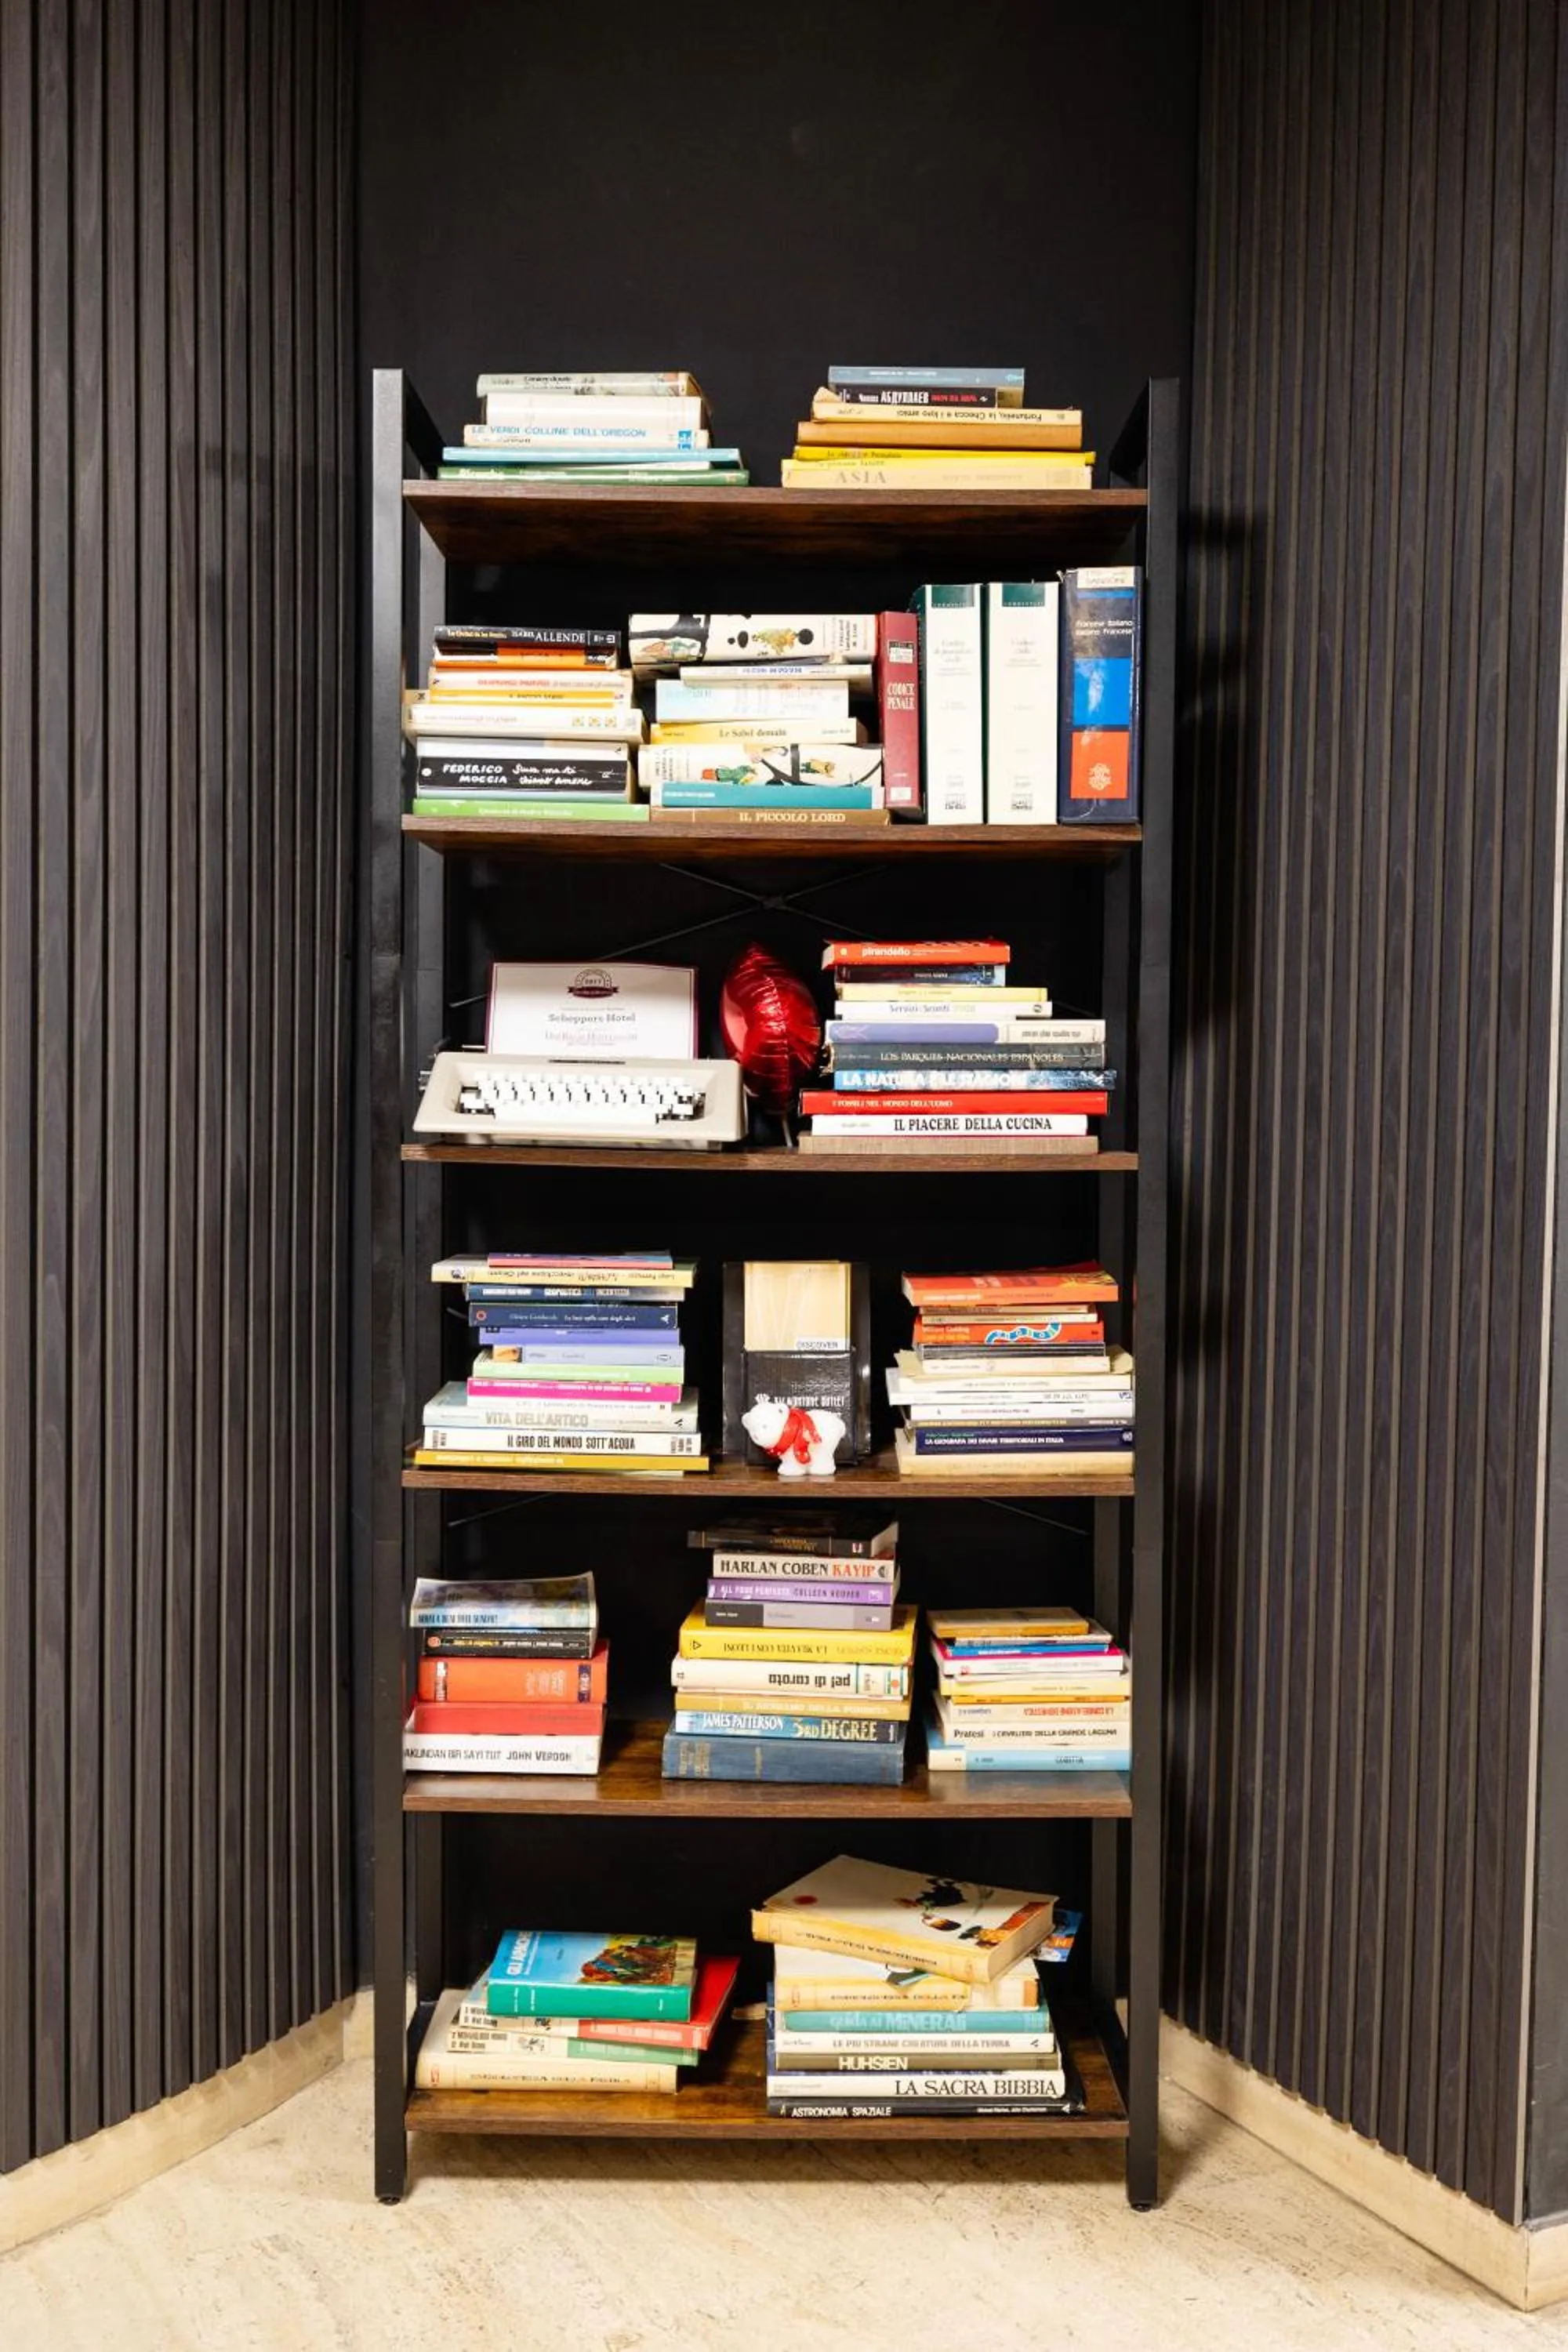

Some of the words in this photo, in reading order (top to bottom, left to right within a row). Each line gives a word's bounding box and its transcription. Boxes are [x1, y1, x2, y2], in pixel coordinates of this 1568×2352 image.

[836, 470, 887, 485] ASIA
[535, 632, 586, 642] ALLENDE
[442, 764, 503, 775] FEDERICO
[459, 775, 507, 784] MOCCIA
[739, 812, 752, 822] IL
[755, 812, 808, 822] PICCOLO
[811, 812, 846, 822] LORD
[606, 1012, 636, 1022] Hotel
[842, 1073, 863, 1087] LA
[894, 1119, 906, 1131] IL
[909, 1119, 960, 1131] PIACERE
[965, 1118, 1003, 1131] DELLA
[1006, 1118, 1052, 1130] CUCINA
[485, 1412, 511, 1425] VITA
[515, 1413, 589, 1427] DELL'ARTICO
[506, 1435, 513, 1447] IL
[516, 1435, 535, 1448] GIRO
[537, 1436, 551, 1448] DEL
[553, 1436, 583, 1449] MONDO
[586, 1436, 636, 1450] SOTT'ACQUA
[720, 1559, 778, 1575] HARLAN
[782, 1561, 829, 1577] COBEN
[832, 1563, 877, 1578] KAYIP
[793, 1587, 828, 1598] COLLEEN
[830, 1588, 861, 1599] HOOVER
[777, 1643, 797, 1653] VITA
[768, 1673, 810, 1686] carota
[815, 1674, 827, 1686] di
[702, 1712, 729, 1727] JAMES
[732, 1714, 784, 1730] PATTERSON
[821, 1720, 877, 1740] DEGREE
[506, 1751, 532, 1761] JOHN
[535, 1751, 573, 1762] VERDON
[950, 2039, 978, 2048] DELLA
[979, 2039, 1011, 2048] TERRA
[838, 2056, 909, 2071] HUHSIEN
[894, 2080, 917, 2096] LA
[924, 2079, 987, 2096] SACRA
[993, 2079, 1058, 2095] BIBBIA
[791, 2107, 848, 2117] ASTRONOMIA
[851, 2106, 891, 2117] SPAZIALE
